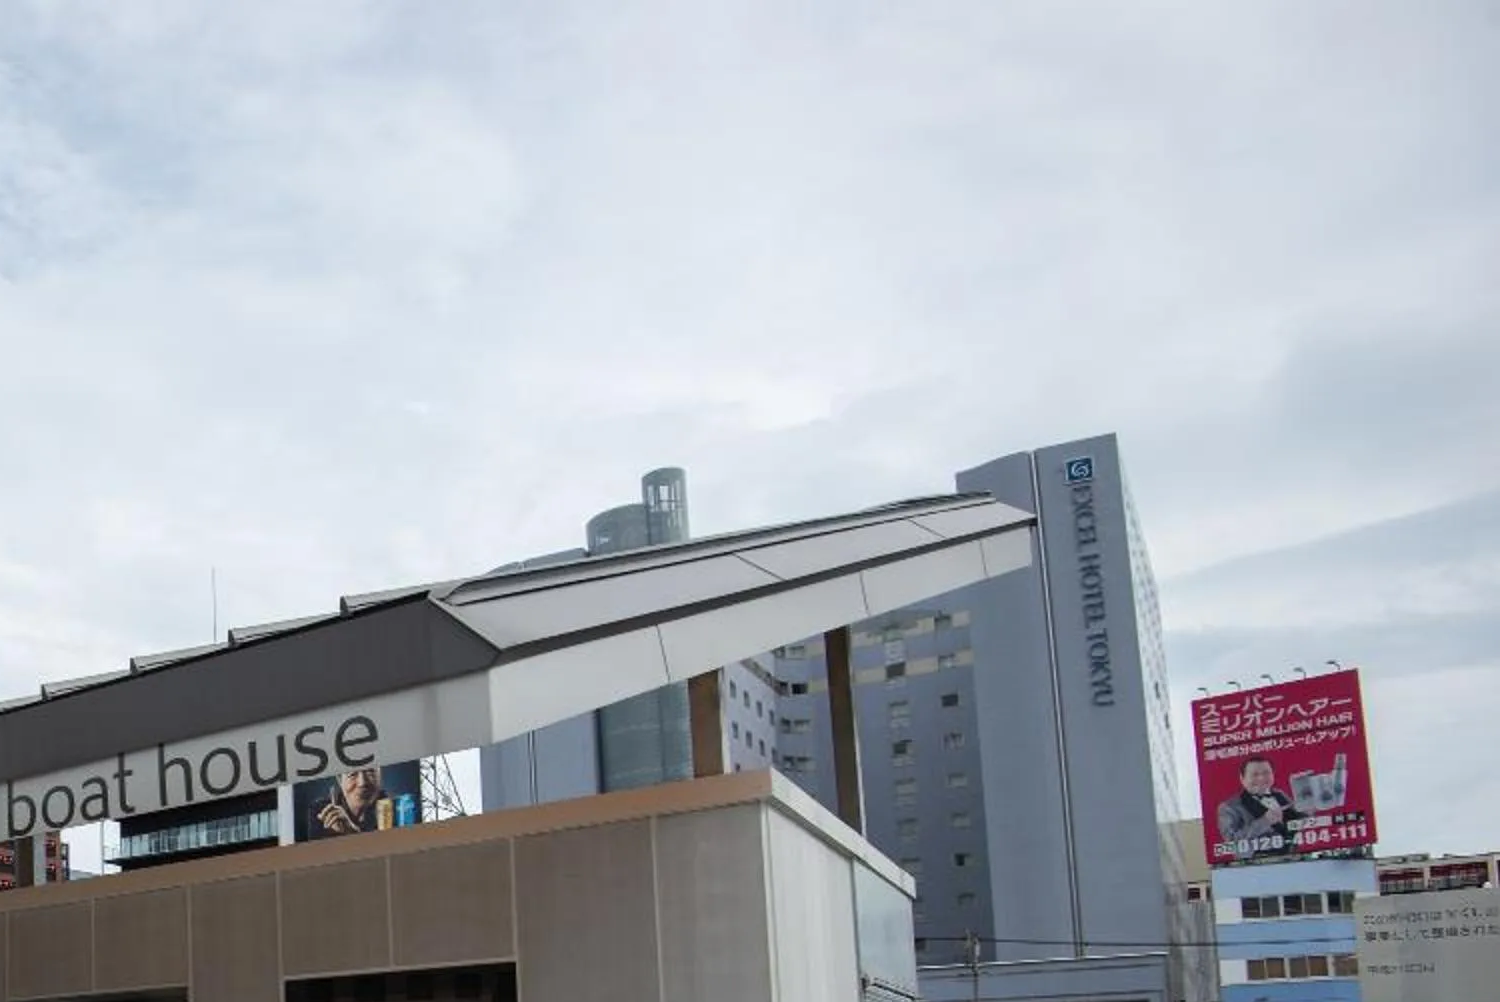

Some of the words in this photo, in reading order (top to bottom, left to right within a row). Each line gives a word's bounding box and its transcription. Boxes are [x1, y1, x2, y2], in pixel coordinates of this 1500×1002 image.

[1078, 552, 1107, 629] HOTEL
[1085, 628, 1116, 708] TOKYU
[1200, 693, 1285, 718] スーパー
[1200, 697, 1353, 734] ミリオンヘアー
[1203, 730, 1253, 748] SUPER
[1255, 720, 1314, 740] MILLION
[1315, 711, 1354, 728] HAIR
[6, 750, 135, 839] boat
[157, 713, 380, 808] house
